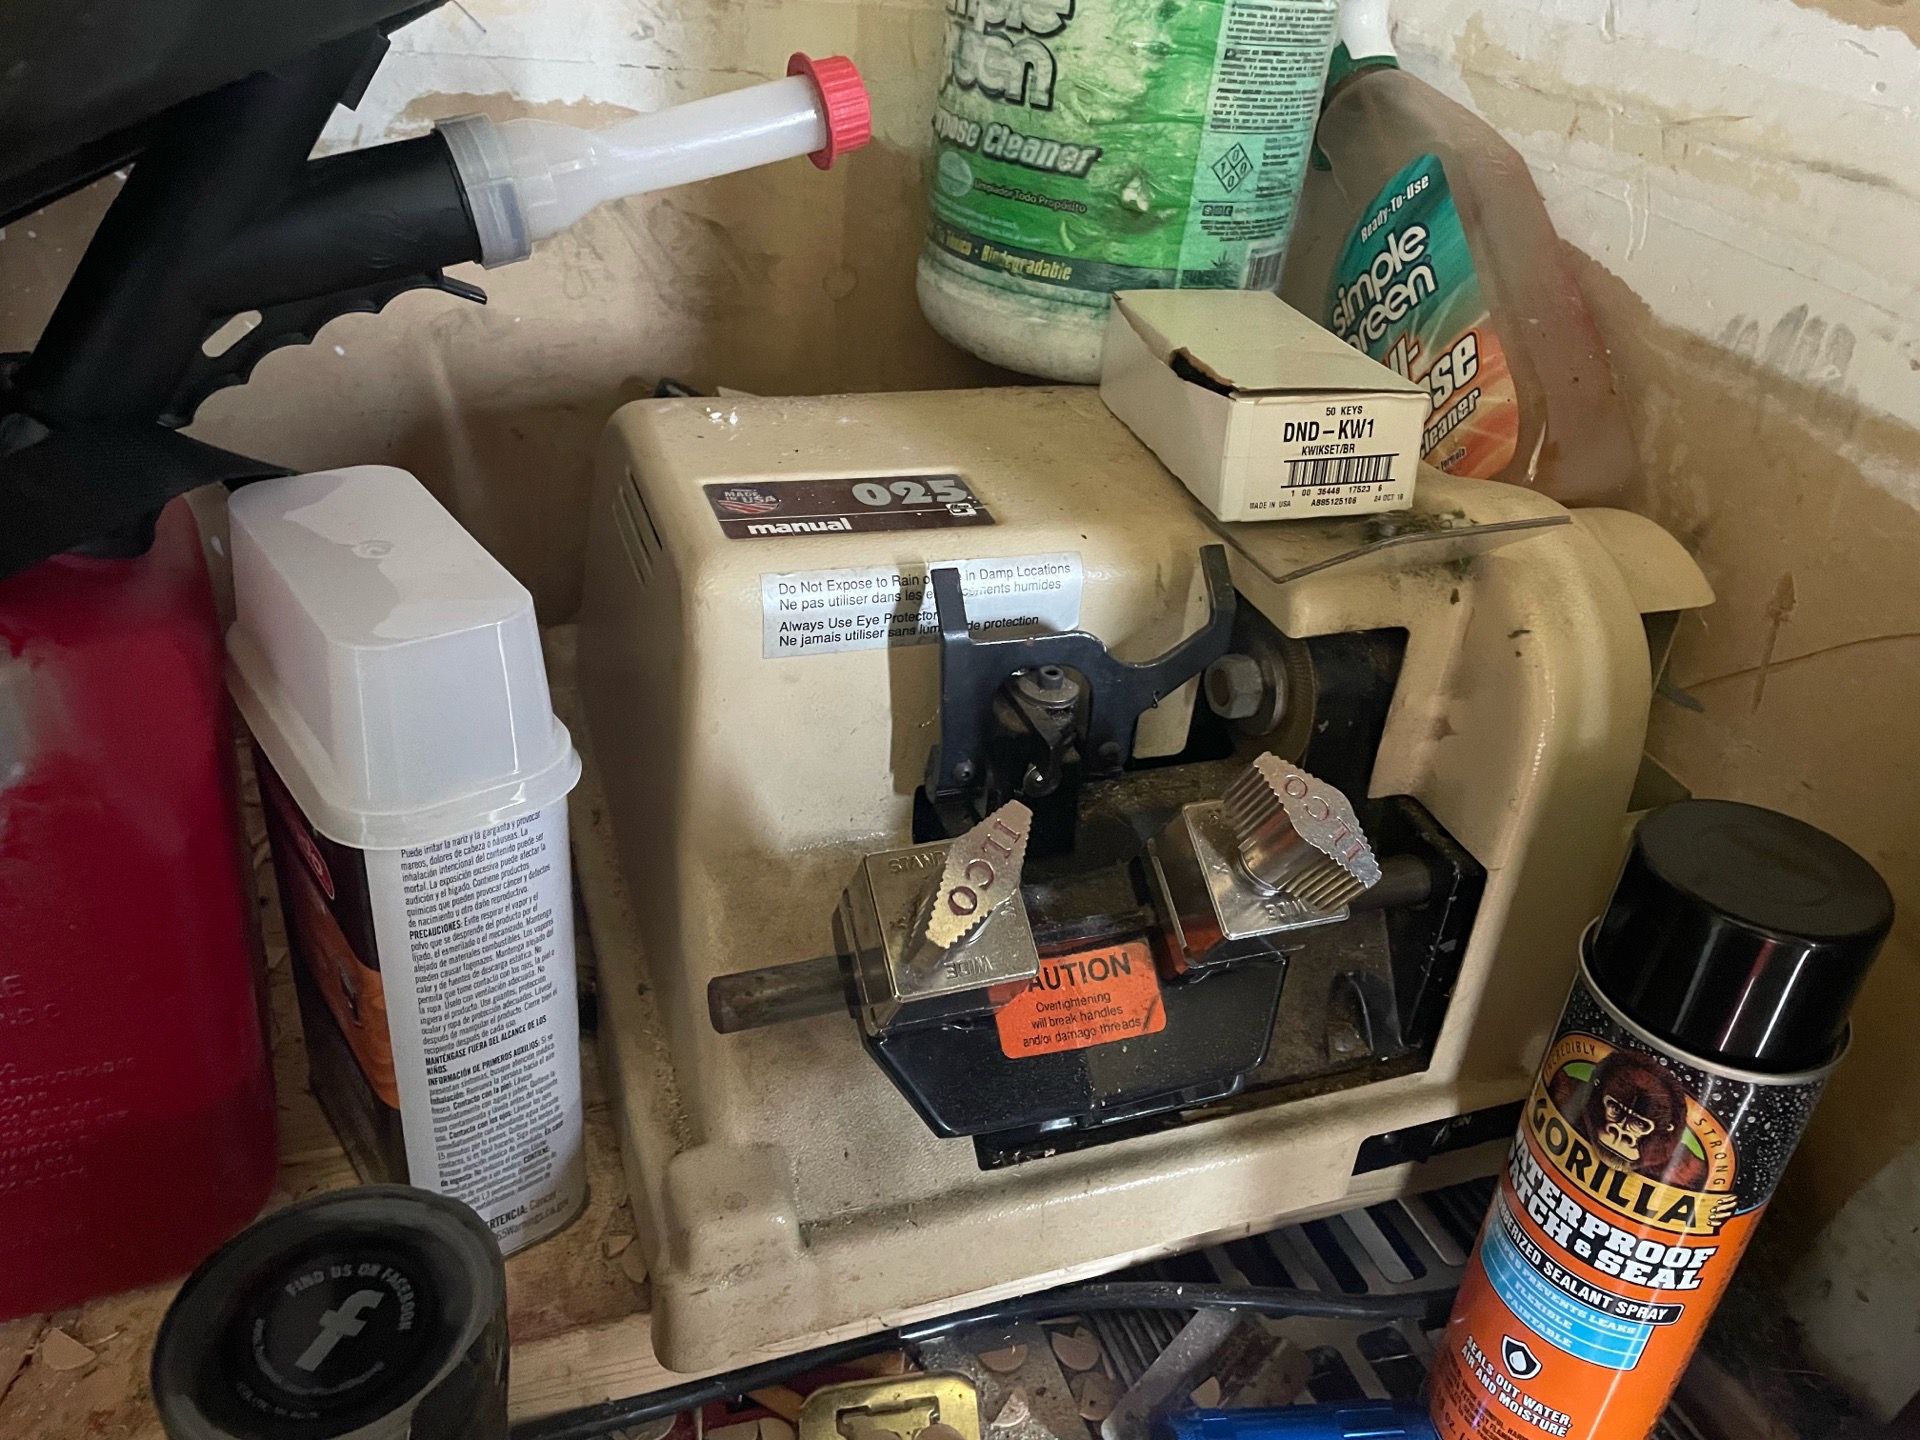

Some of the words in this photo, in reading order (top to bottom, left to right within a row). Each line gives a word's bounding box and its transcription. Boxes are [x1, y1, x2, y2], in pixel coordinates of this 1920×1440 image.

[983, 121, 1102, 177] Cleaner
[1014, 189, 1037, 204] Todo
[1361, 175, 1429, 243] Ready-To-Use
[981, 244, 1073, 281] Biodegradable
[1332, 225, 1427, 338] simple
[1325, 407, 1336, 416] 50
[1340, 405, 1363, 416] KEYS
[1301, 444, 1356, 456] KWIKSET/BR
[742, 495, 777, 504] USA
[852, 480, 968, 506] 025
[748, 518, 852, 535] manual
[779, 583, 796, 595] Do
[801, 581, 822, 593] Not
[827, 579, 872, 592] Expose
[876, 577, 888, 588] to
[892, 575, 919, 587] Rain
[966, 570, 975, 581] in
[980, 568, 1013, 581] Damp
[1017, 564, 1071, 577] Locations
[780, 599, 797, 611] Ne
[802, 598, 824, 612] pas
[828, 594, 867, 607] utiliser
[871, 591, 901, 604] dans
[905, 589, 922, 601] les
[1014, 579, 1061, 592] humides
[779, 619, 824, 633] Always
[828, 616, 852, 629] Use
[856, 615, 879, 628] Eye
[779, 635, 797, 647] Ne
[800, 632, 841, 648] jamais
[845, 628, 884, 642] utiliser
[888, 626, 916, 638] sans
[967, 621, 980, 631] de
[983, 615, 1039, 631] protection
[1284, 774, 1366, 863] ILCO
[401, 846, 422, 859] Puede
[444, 838, 450, 848] la
[474, 830, 480, 839] la
[401, 858, 428, 872] mareos,
[429, 852, 452, 864] dolores
[454, 849, 461, 857] de
[463, 841, 485, 854] cabeza
[520, 827, 528, 836] La
[402, 867, 436, 882] inhalación
[439, 856, 473, 874] intencional
[475, 853, 484, 863] del
[486, 843, 515, 859] contenido
[517, 836, 534, 850] puede
[429, 879, 437, 888] La
[439, 869, 471, 887] exposición
[473, 860, 498, 875] excesiva
[500, 854, 517, 867] puede
[519, 846, 539, 859] afectar
[540, 842, 545, 850] la
[948, 818, 1021, 916] ILCO
[409, 920, 462, 938] PRECAUCIONES:
[1027, 952, 1132, 993] AUTION
[1031, 1016, 1048, 1030] will
[1049, 1013, 1078, 1028] break
[1080, 1005, 1123, 1021] handles
[1036, 992, 1111, 1013] Overtightening
[425, 1047, 465, 1065] MANTÉNGASE
[467, 1039, 487, 1053] FUERA
[488, 1034, 498, 1045] DEL
[500, 1023, 525, 1041] ALCANCE
[527, 1020, 534, 1029] DE
[536, 1014, 546, 1025] LOS
[1056, 1027, 1097, 1044] damage
[1100, 1017, 1141, 1034] threads
[428, 1067, 471, 1086] INFORMACIÓN
[472, 1063, 480, 1073] DE
[482, 1050, 511, 1069] PRIMEROS
[1532, 1098, 1698, 1229] GORILLA
[1693, 1117, 1729, 1186] STRONG
[1509, 1152, 1573, 1249] ATCH
[1574, 1239, 1592, 1259] &
[1594, 1249, 1702, 1291] SEAL
[330, 1264, 352, 1278] US
[1515, 1281, 1573, 1330] FLEXIBLE
[1543, 1262, 1613, 1309] SEALANT
[1615, 1301, 1669, 1321] SPRAY
[1506, 1292, 1573, 1347] PAINTABLE
[1589, 1314, 1637, 1334] LEAKS
[1461, 1345, 1476, 1369] AIR
[1475, 1369, 1497, 1394] AND
[1498, 1391, 1567, 1437] MOISTURE
[1467, 1336, 1495, 1376] SEALS
[1495, 1373, 1521, 1398] OUT
[1522, 1393, 1573, 1428] WATER,
